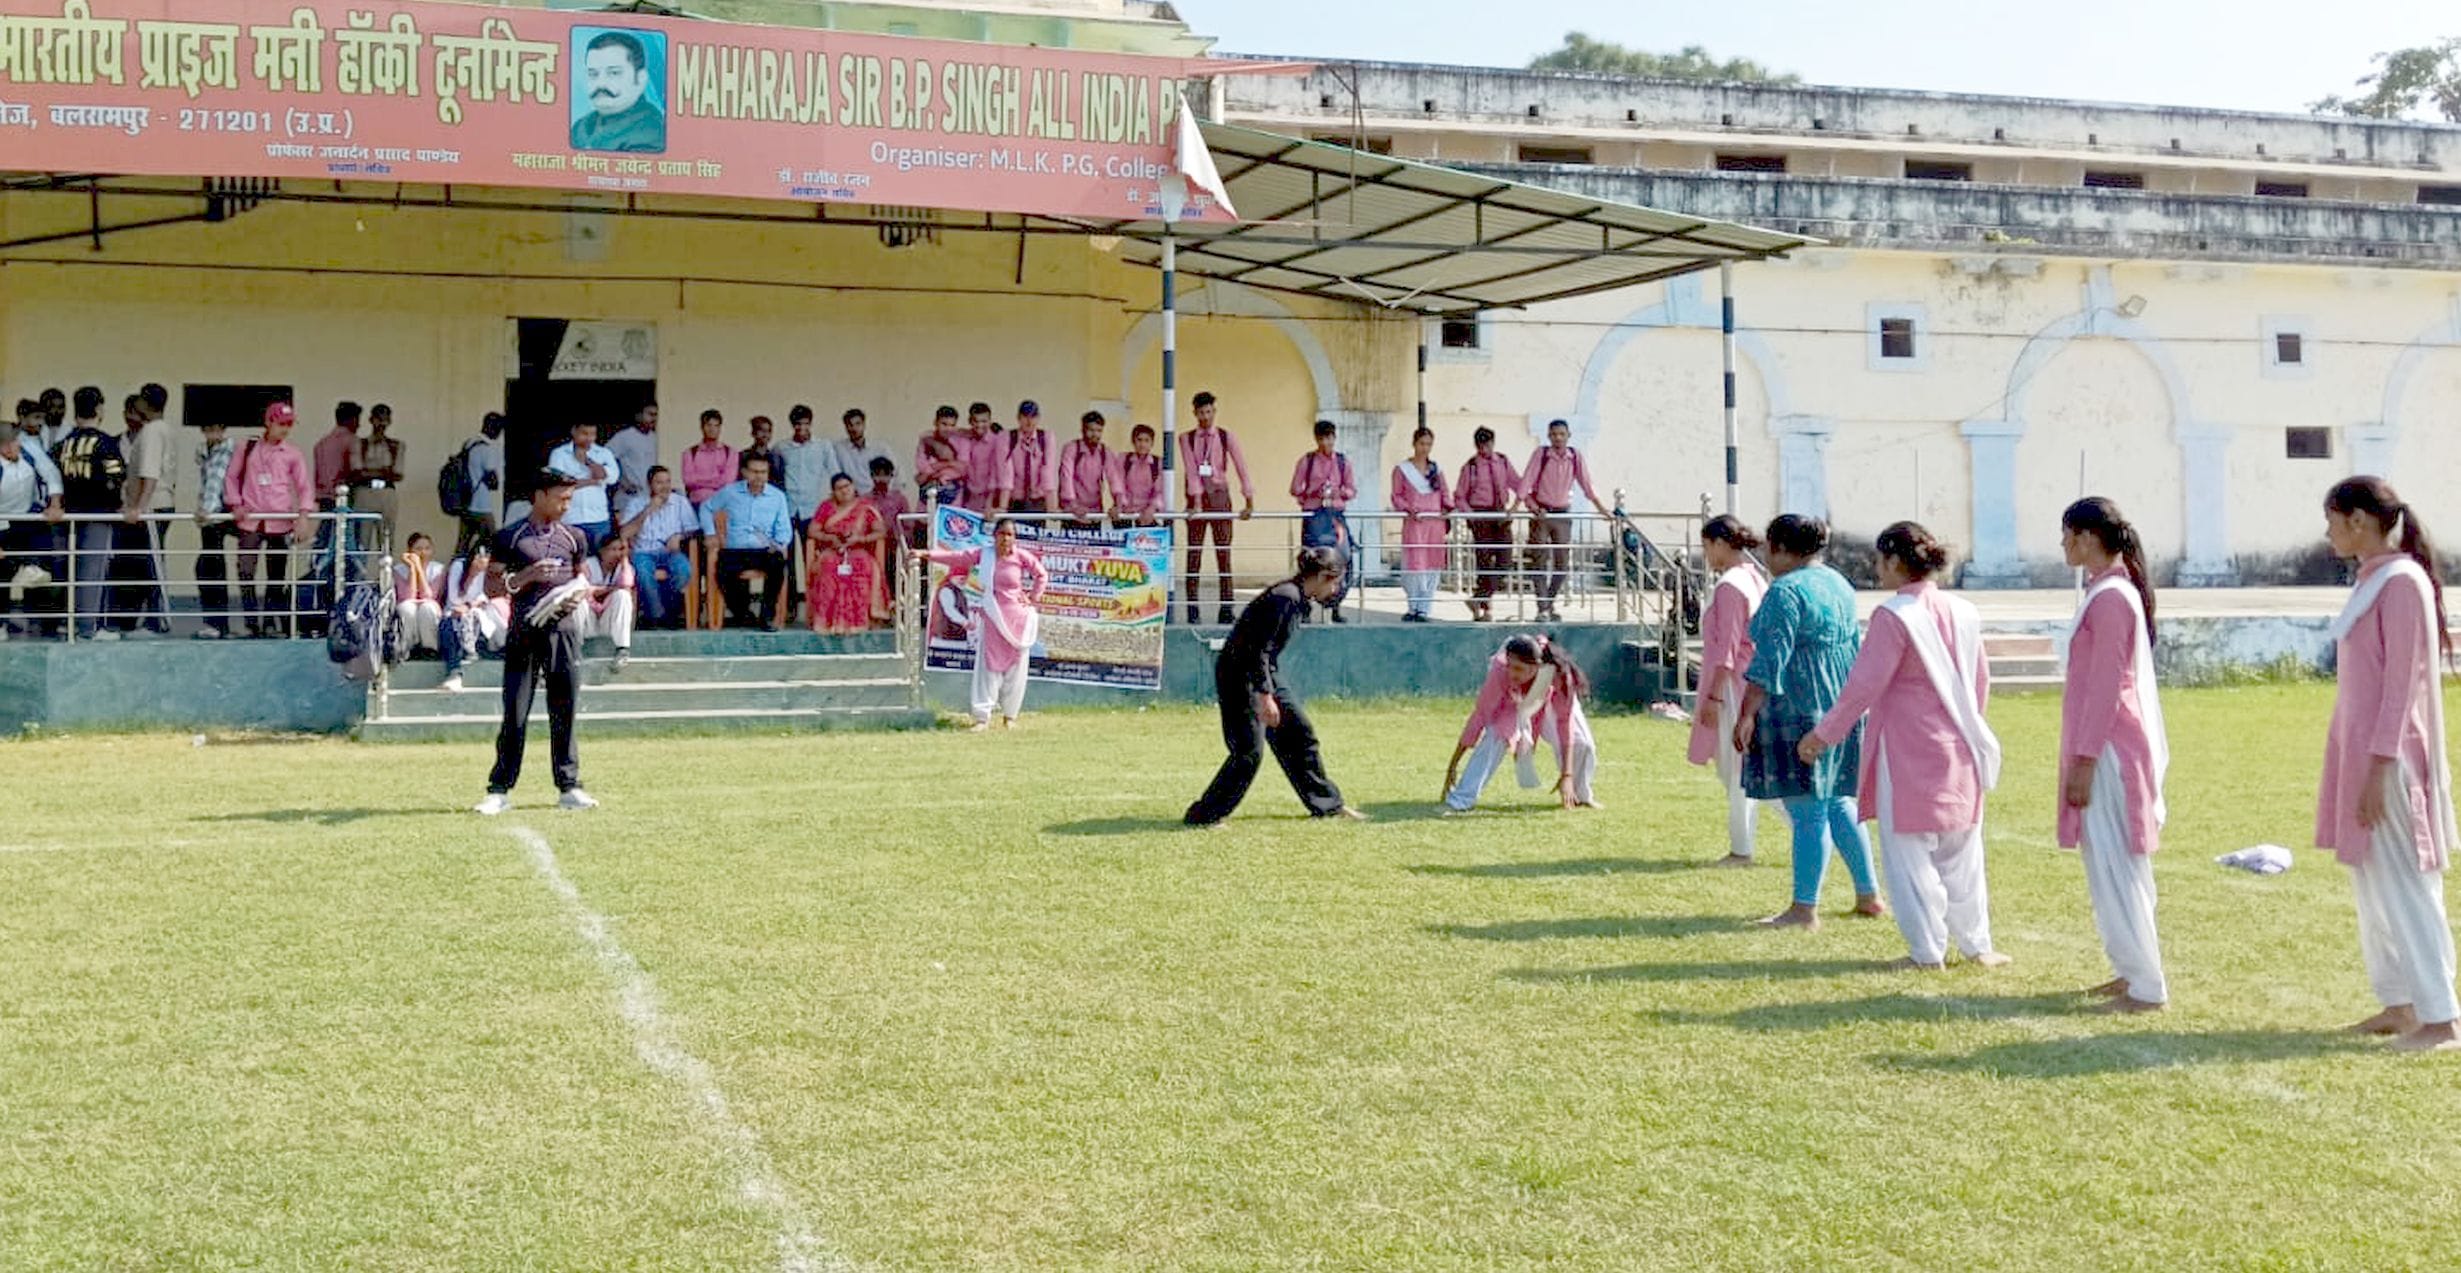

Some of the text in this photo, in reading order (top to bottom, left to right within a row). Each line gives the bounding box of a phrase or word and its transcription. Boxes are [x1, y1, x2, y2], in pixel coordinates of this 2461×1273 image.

[136, 19, 240, 99] प्राइज
[248, 8, 325, 92] मनी
[334, 9, 423, 97] हॉकी
[676, 43, 832, 126] MAHARAJA
[838, 52, 883, 128] SIR
[889, 57, 934, 131] B.P.
[941, 61, 1021, 137] SINGH
[1026, 67, 1075, 141] ALL
[1081, 72, 1151, 146] INDIA
[49, 105, 150, 136] बलरामपुर
[179, 108, 273, 132] 271201
[870, 141, 984, 170] Organiser:
[990, 149, 1055, 174] M.L.K.
[1093, 559, 1145, 584] YUVA
